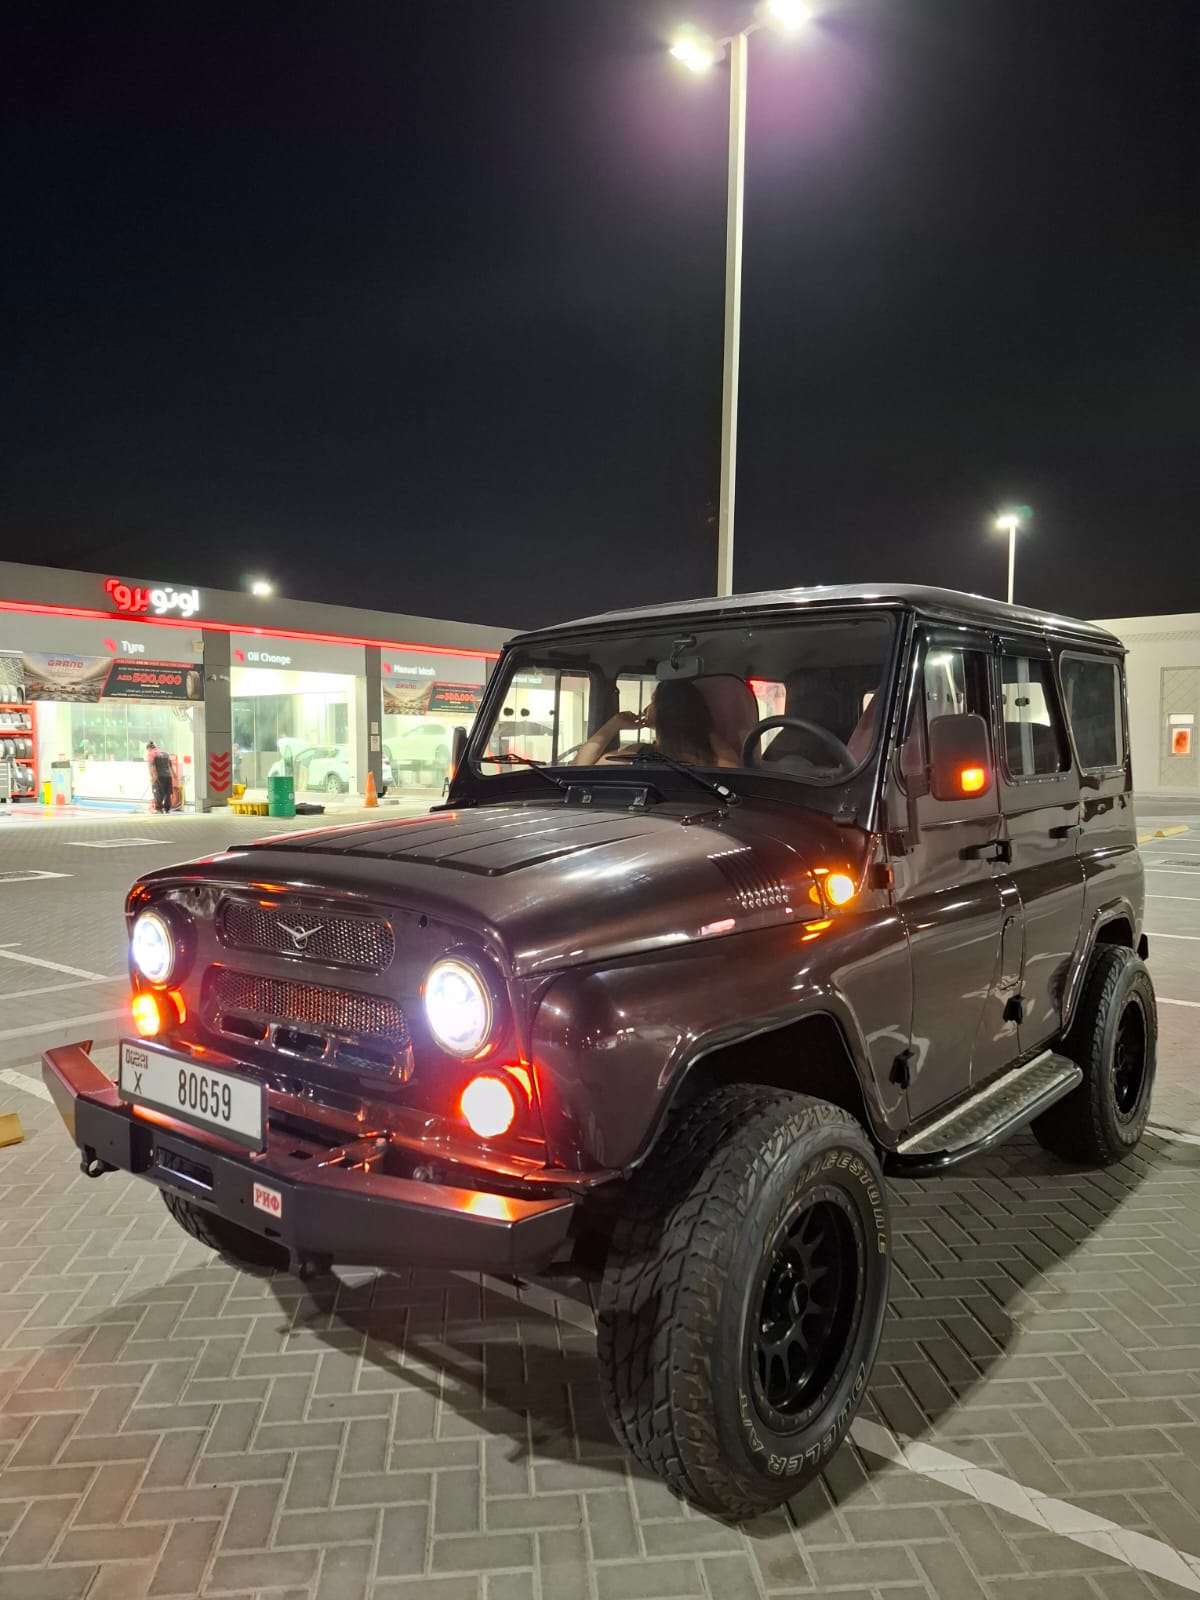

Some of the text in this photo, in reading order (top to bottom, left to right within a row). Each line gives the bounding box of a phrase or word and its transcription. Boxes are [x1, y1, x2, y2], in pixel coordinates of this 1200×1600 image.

[121, 640, 145, 654] Tyre
[47, 659, 84, 669] GRAND
[247, 651, 292, 666] Oil Change
[132, 672, 183, 686] 500,000
[134, 1068, 232, 1122] X 80659
[255, 1188, 280, 1212] РИФ
[767, 1361, 866, 1476] DUELER
